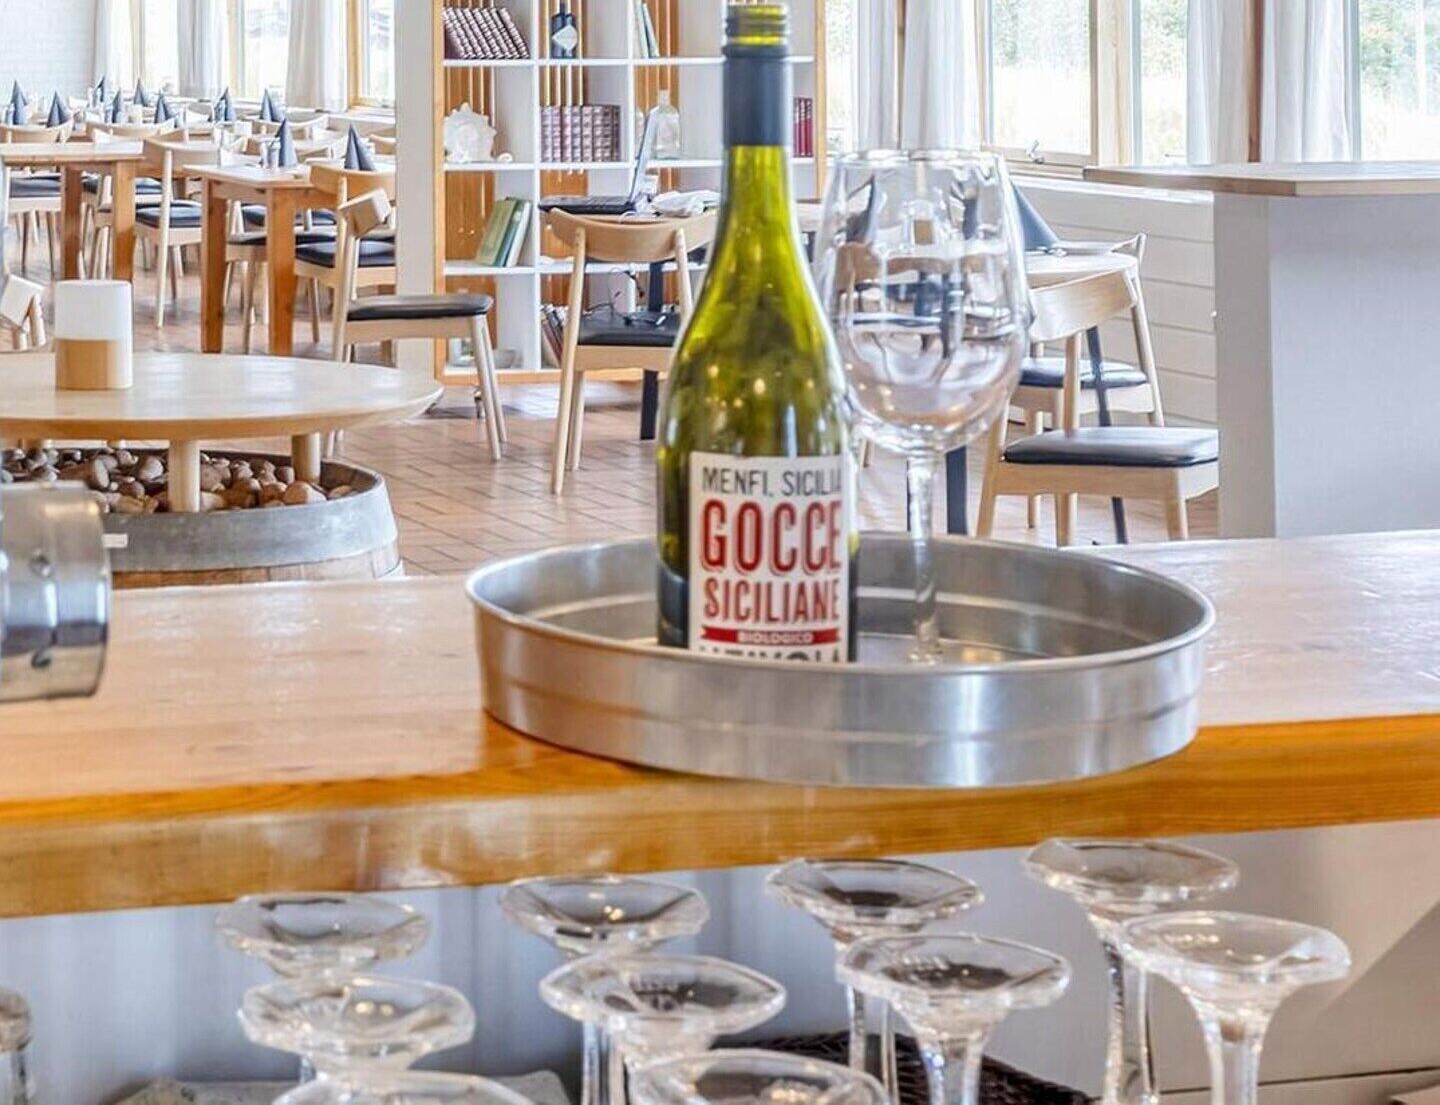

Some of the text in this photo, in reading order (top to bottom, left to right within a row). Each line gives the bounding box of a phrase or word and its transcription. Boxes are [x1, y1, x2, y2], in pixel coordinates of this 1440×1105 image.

[701, 498, 842, 576] GOCCE
[704, 577, 839, 623] SICILIANE
[737, 631, 814, 644] BIOLOGICO
